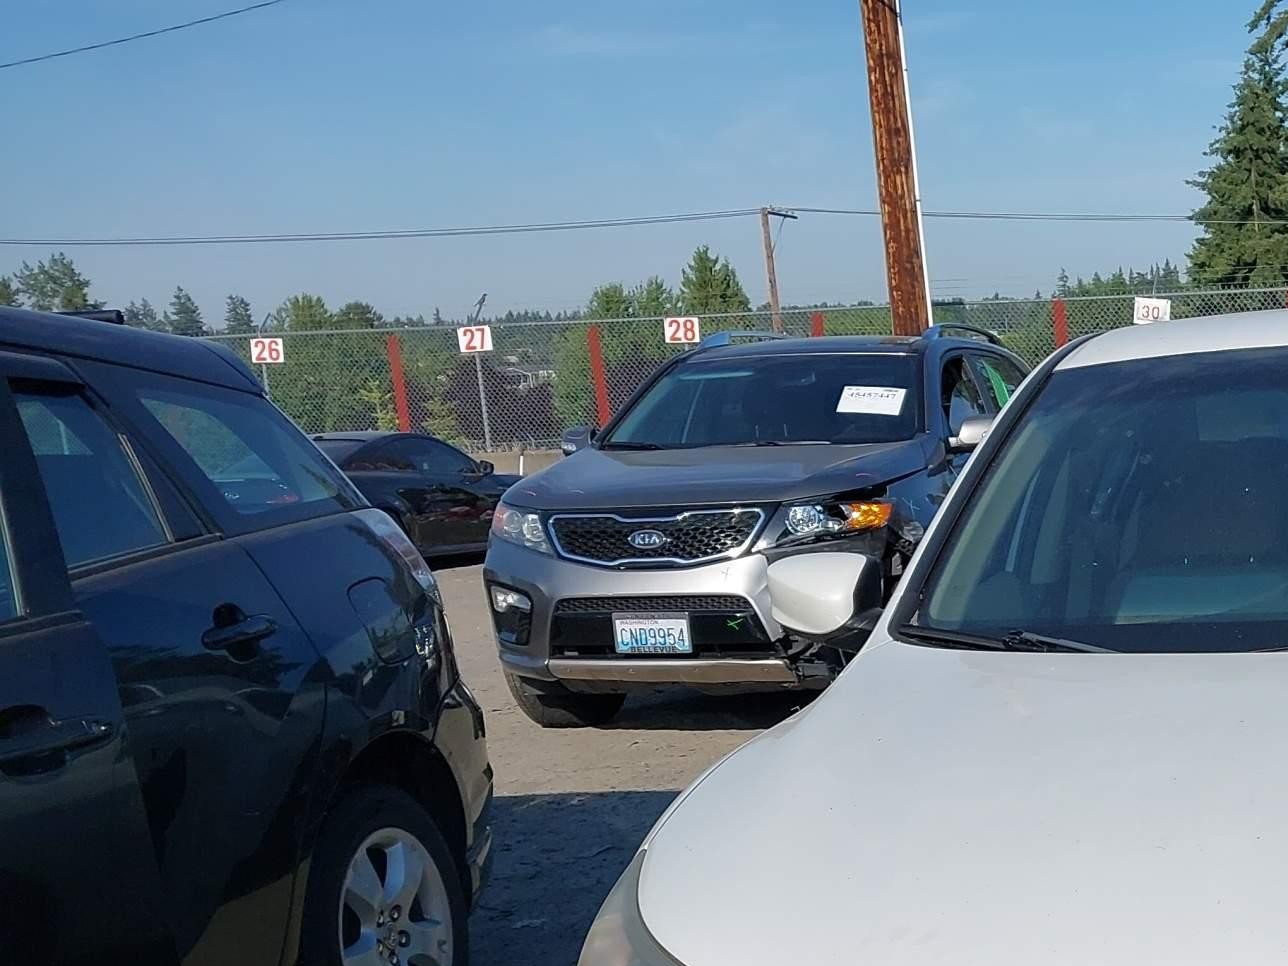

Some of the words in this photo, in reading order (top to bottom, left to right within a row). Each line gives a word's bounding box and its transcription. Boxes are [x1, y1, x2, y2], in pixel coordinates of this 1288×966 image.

[1142, 305, 1160, 320] 30
[462, 328, 486, 351] 27
[668, 319, 696, 342] 28
[254, 340, 281, 362] 26
[634, 533, 660, 545] KIA
[630, 645, 678, 653] BELLEVUE
